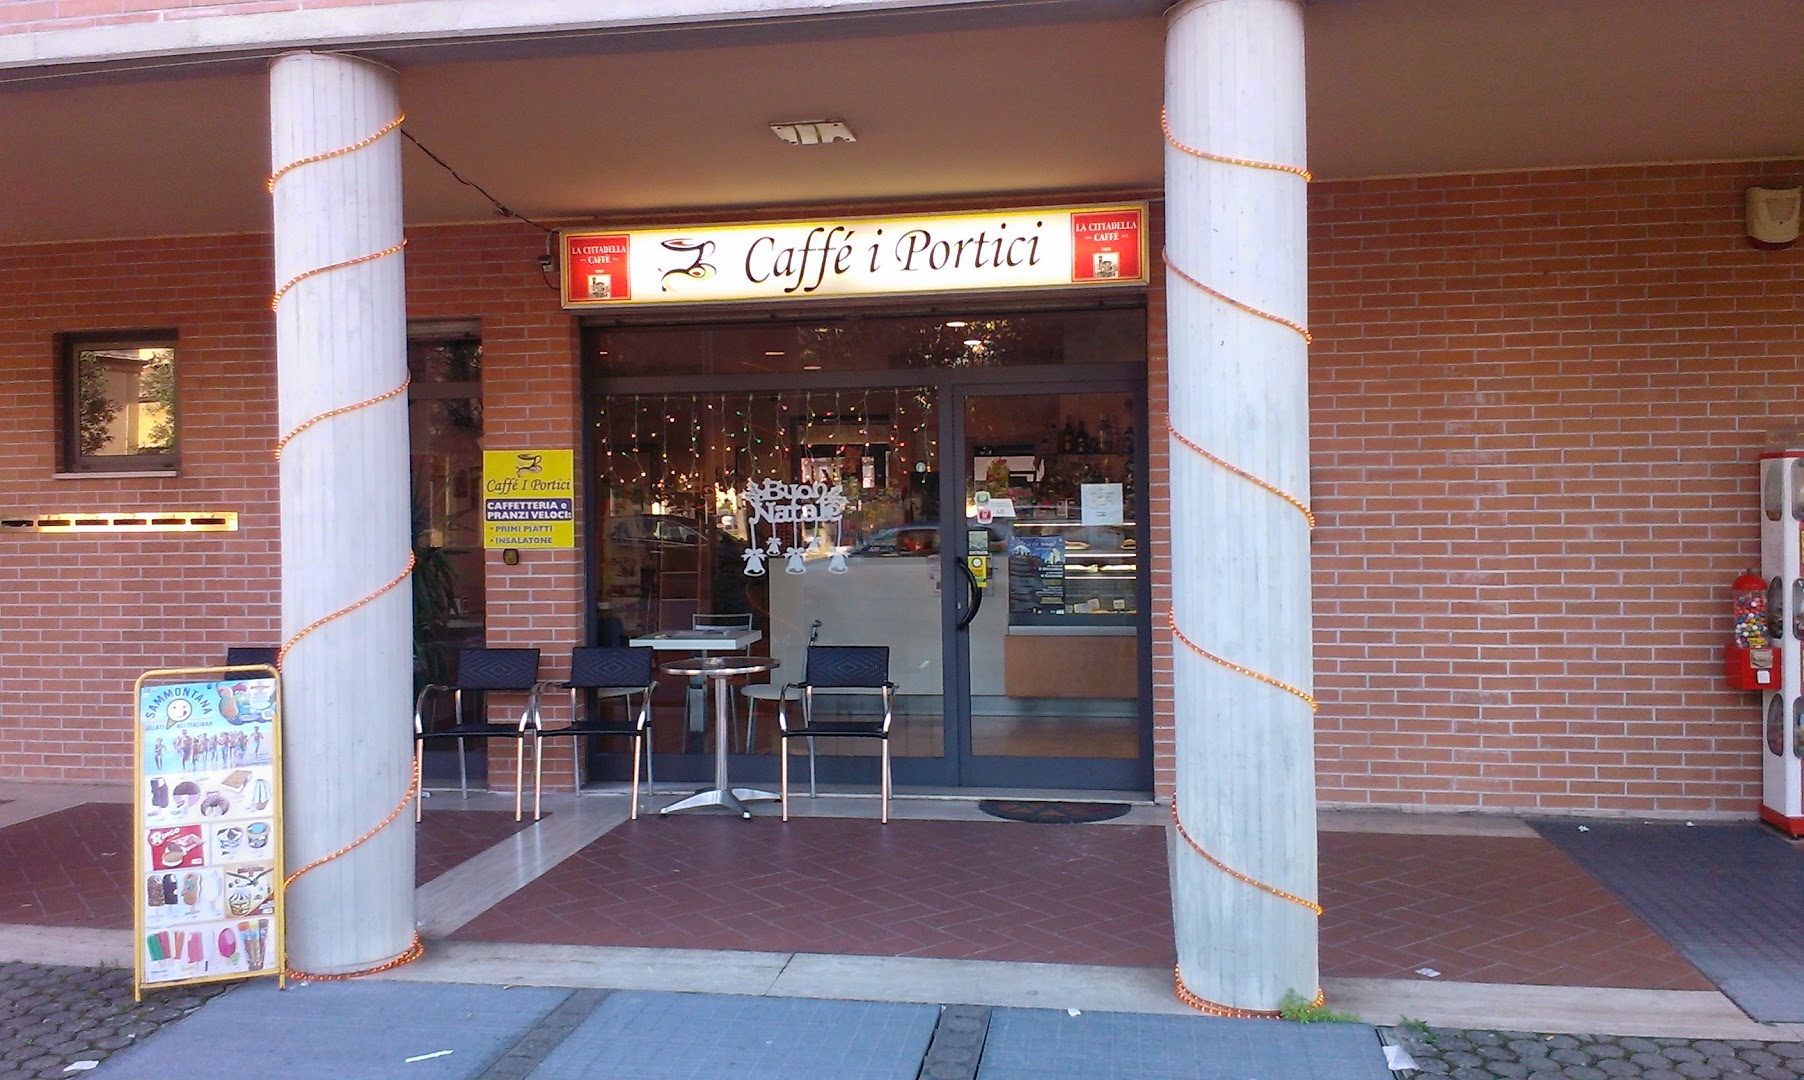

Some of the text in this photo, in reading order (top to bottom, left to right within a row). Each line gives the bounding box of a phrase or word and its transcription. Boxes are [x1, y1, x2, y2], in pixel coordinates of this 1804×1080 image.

[1076, 220, 1137, 232] LA CITTADELLA
[571, 245, 627, 255] LA CITTADELLA
[745, 220, 1043, 293] Caffé i Portici
[487, 478, 571, 495] Caffé I Portici
[487, 501, 567, 510] CAFFETTERIA e
[487, 510, 572, 520] PRANZI VELOCI:
[145, 687, 213, 719] SAMMONTANA
